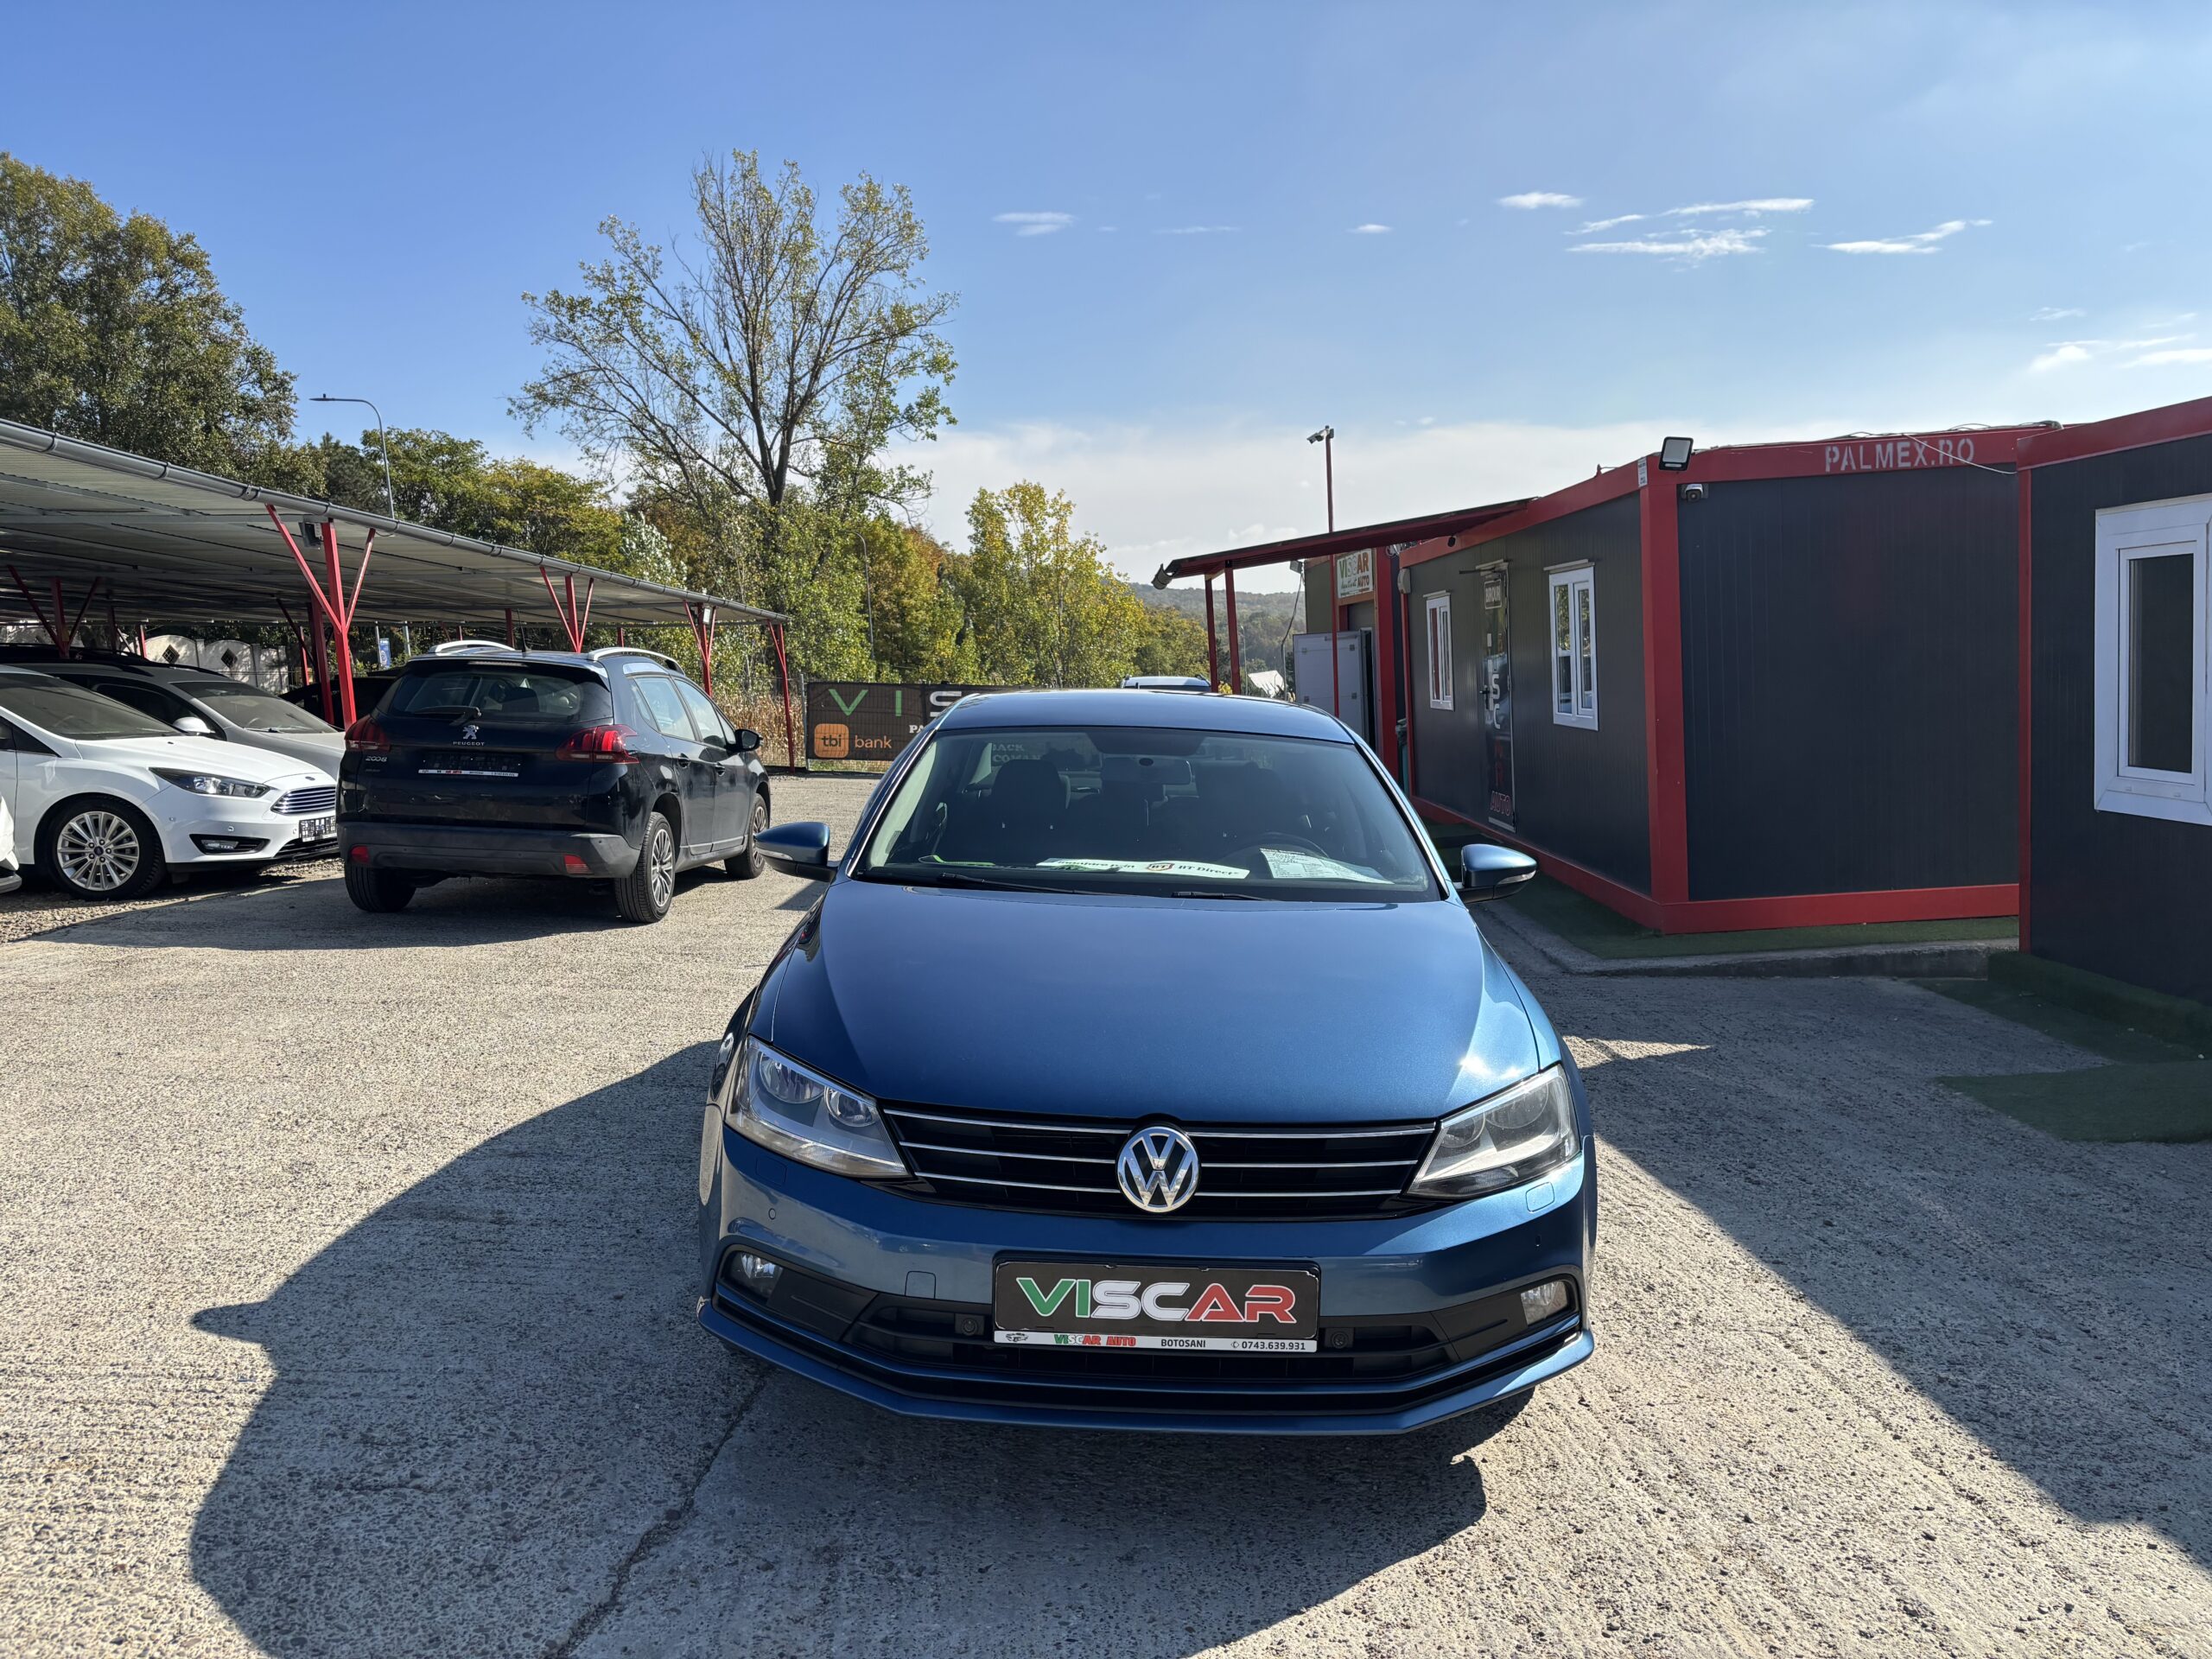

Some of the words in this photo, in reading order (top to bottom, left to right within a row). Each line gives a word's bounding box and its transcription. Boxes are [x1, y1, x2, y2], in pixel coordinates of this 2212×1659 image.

[1825, 438, 1975, 473] PALMEX.RO
[822, 734, 842, 747] tbi
[855, 735, 893, 749] bank
[1491, 791, 1511, 817] AUTO
[1016, 1277, 1297, 1324] VISCAR
[1054, 1334, 1102, 1345] VISCAR
[1106, 1336, 1136, 1346] AUTO
[1160, 1339, 1206, 1348] BOTOSANI
[1242, 1341, 1306, 1351] 0743.639.931
